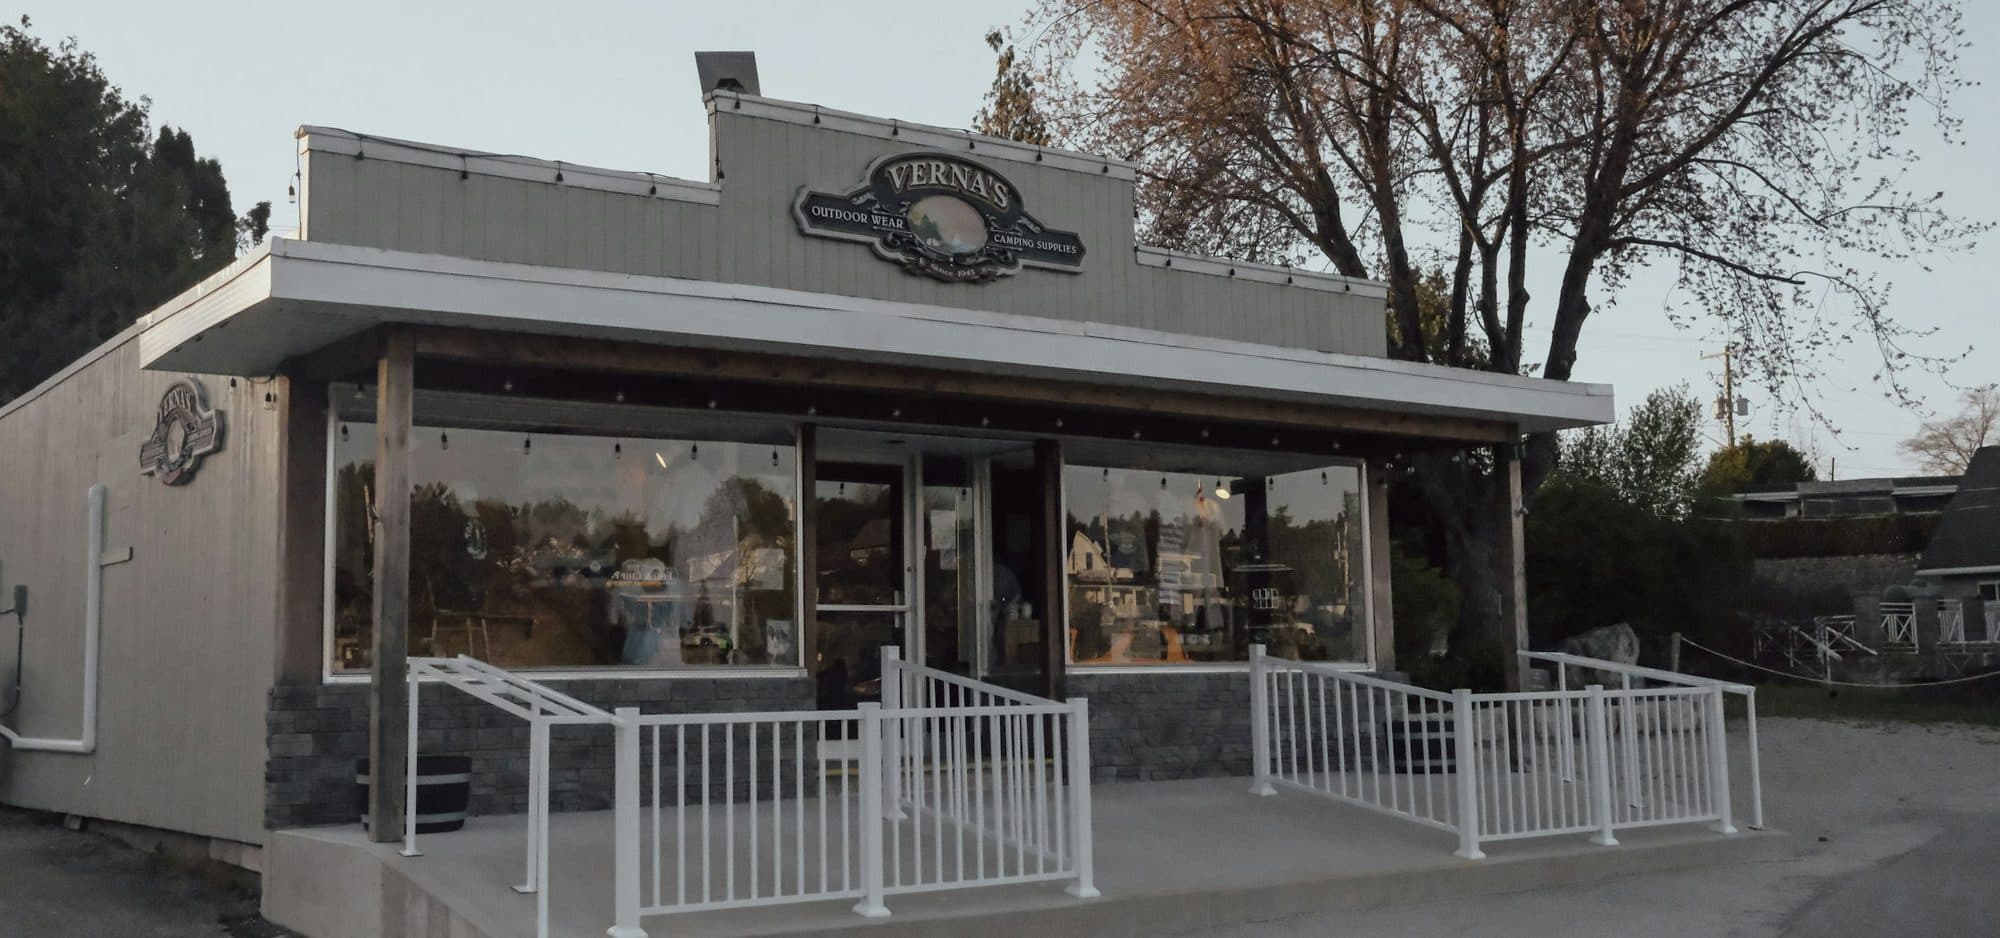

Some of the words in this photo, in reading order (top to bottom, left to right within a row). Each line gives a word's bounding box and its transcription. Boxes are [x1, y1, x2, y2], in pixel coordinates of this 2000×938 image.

[887, 160, 1009, 209] VERNA'S
[812, 205, 868, 224] OUTDOOR
[871, 215, 904, 229] WEAR
[994, 233, 1034, 248] CAMPING
[1037, 240, 1078, 254] SUPPLIES
